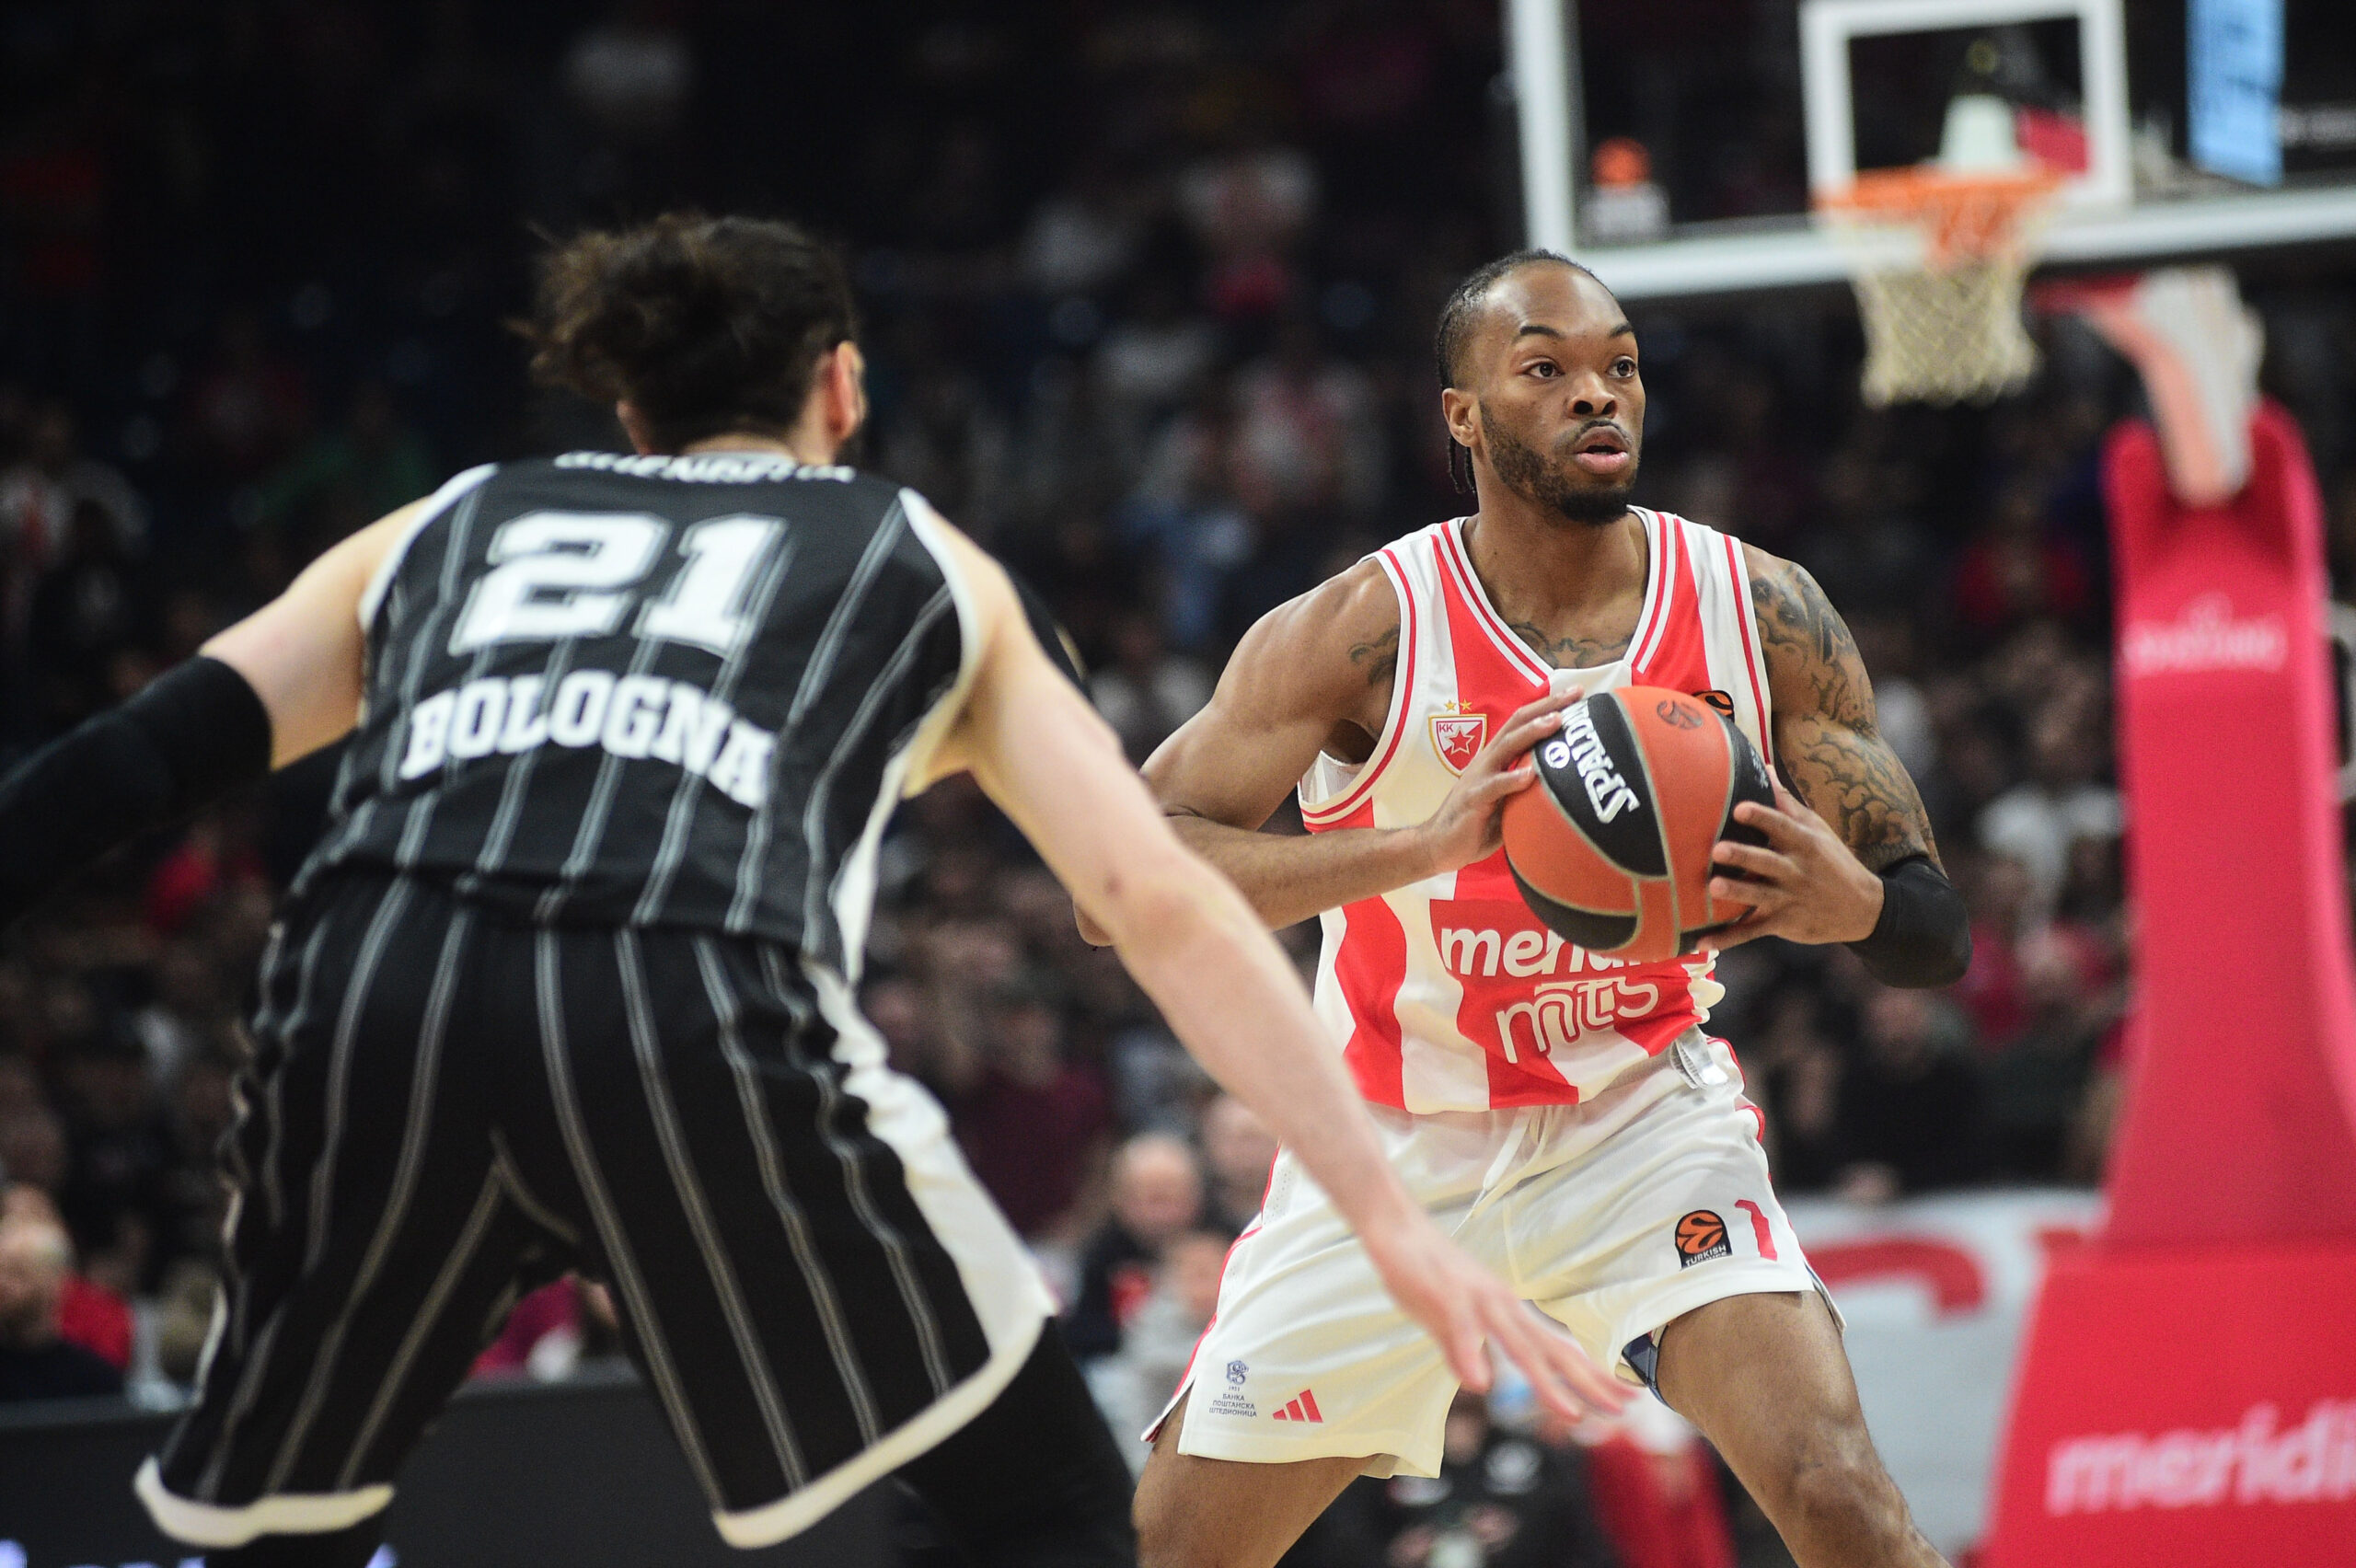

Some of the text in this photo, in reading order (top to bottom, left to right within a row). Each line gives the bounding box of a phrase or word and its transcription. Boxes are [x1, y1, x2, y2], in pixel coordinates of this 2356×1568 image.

[448, 510, 789, 660] 21
[398, 669, 776, 809] BOLOGNA
[1561, 698, 1640, 824] SPALDIN
[1496, 976, 1658, 1064] mts
[1685, 1243, 1727, 1267] TURKISH
[1734, 1199, 1778, 1262] 1
[1208, 1407, 1257, 1417] ШТЕДИОНИЦА
[1213, 1400, 1254, 1410] ПОШТАНСКА
